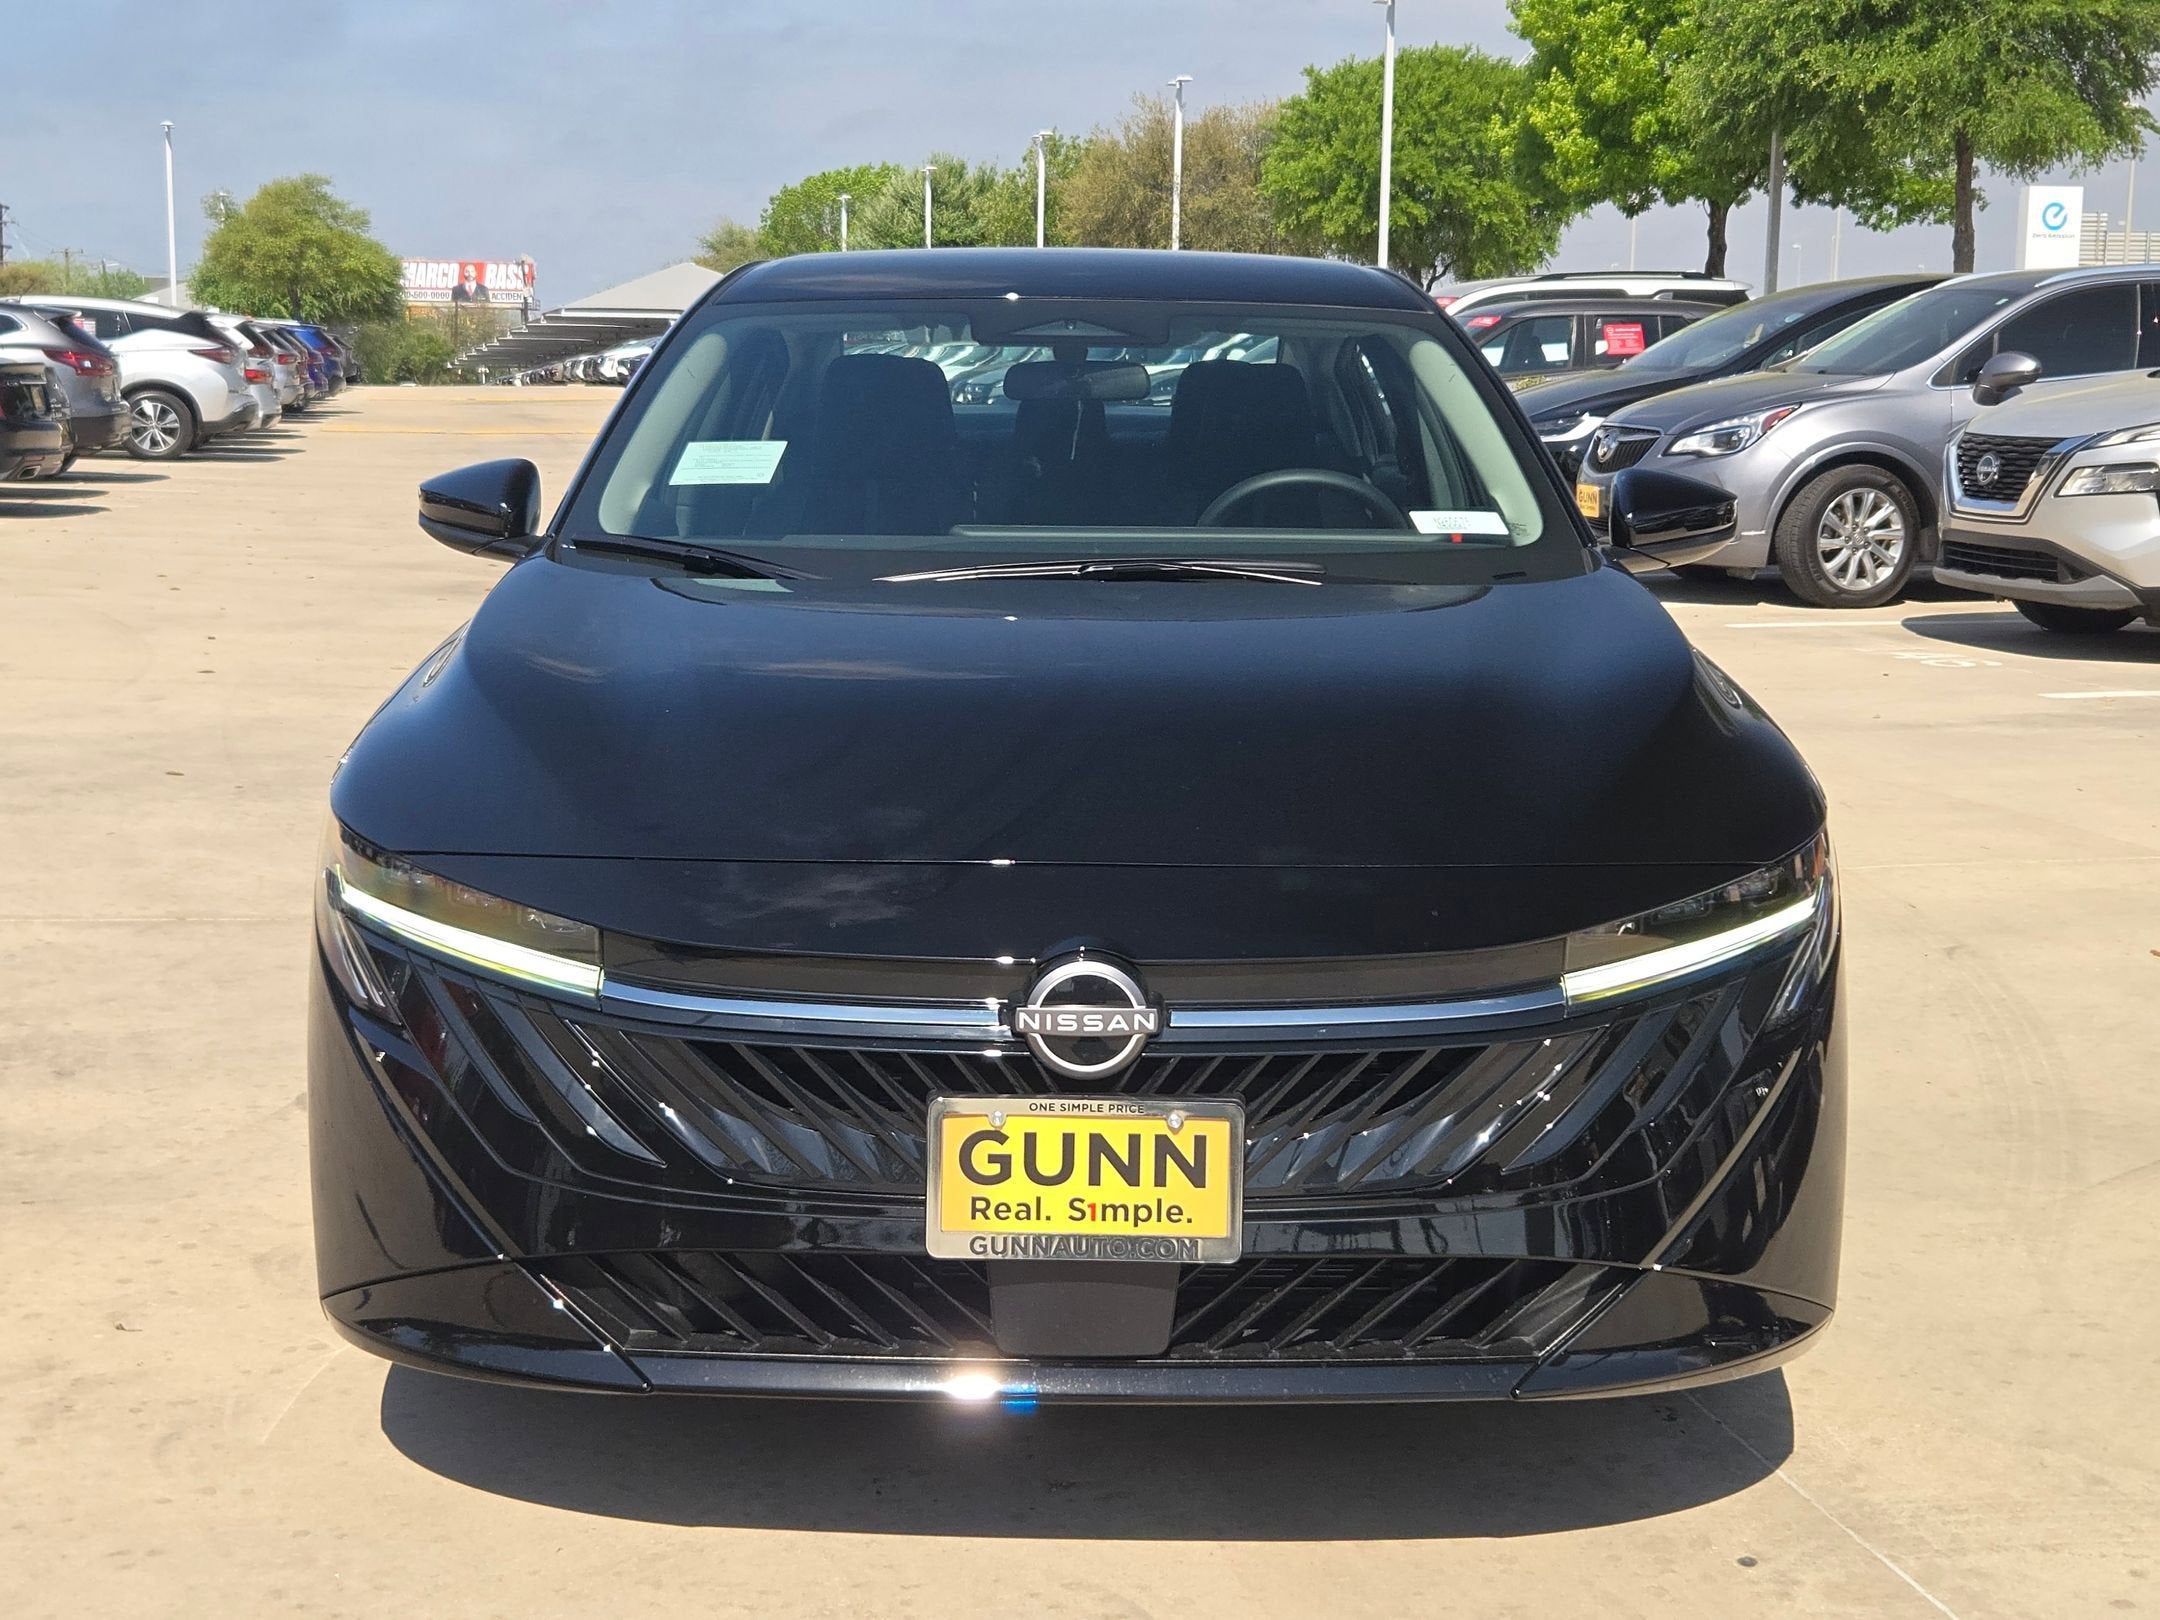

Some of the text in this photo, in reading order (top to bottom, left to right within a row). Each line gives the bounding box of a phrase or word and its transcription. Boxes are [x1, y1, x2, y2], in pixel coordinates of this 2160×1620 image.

[1018, 1011, 1156, 1033] NISSAN
[1028, 1102, 1145, 1114] ONE SIMPLE PRICE
[958, 1129, 1207, 1189] GUNN
[970, 1196, 1052, 1221] Real.
[969, 1235, 1200, 1260] GUNNAUTO.COM
